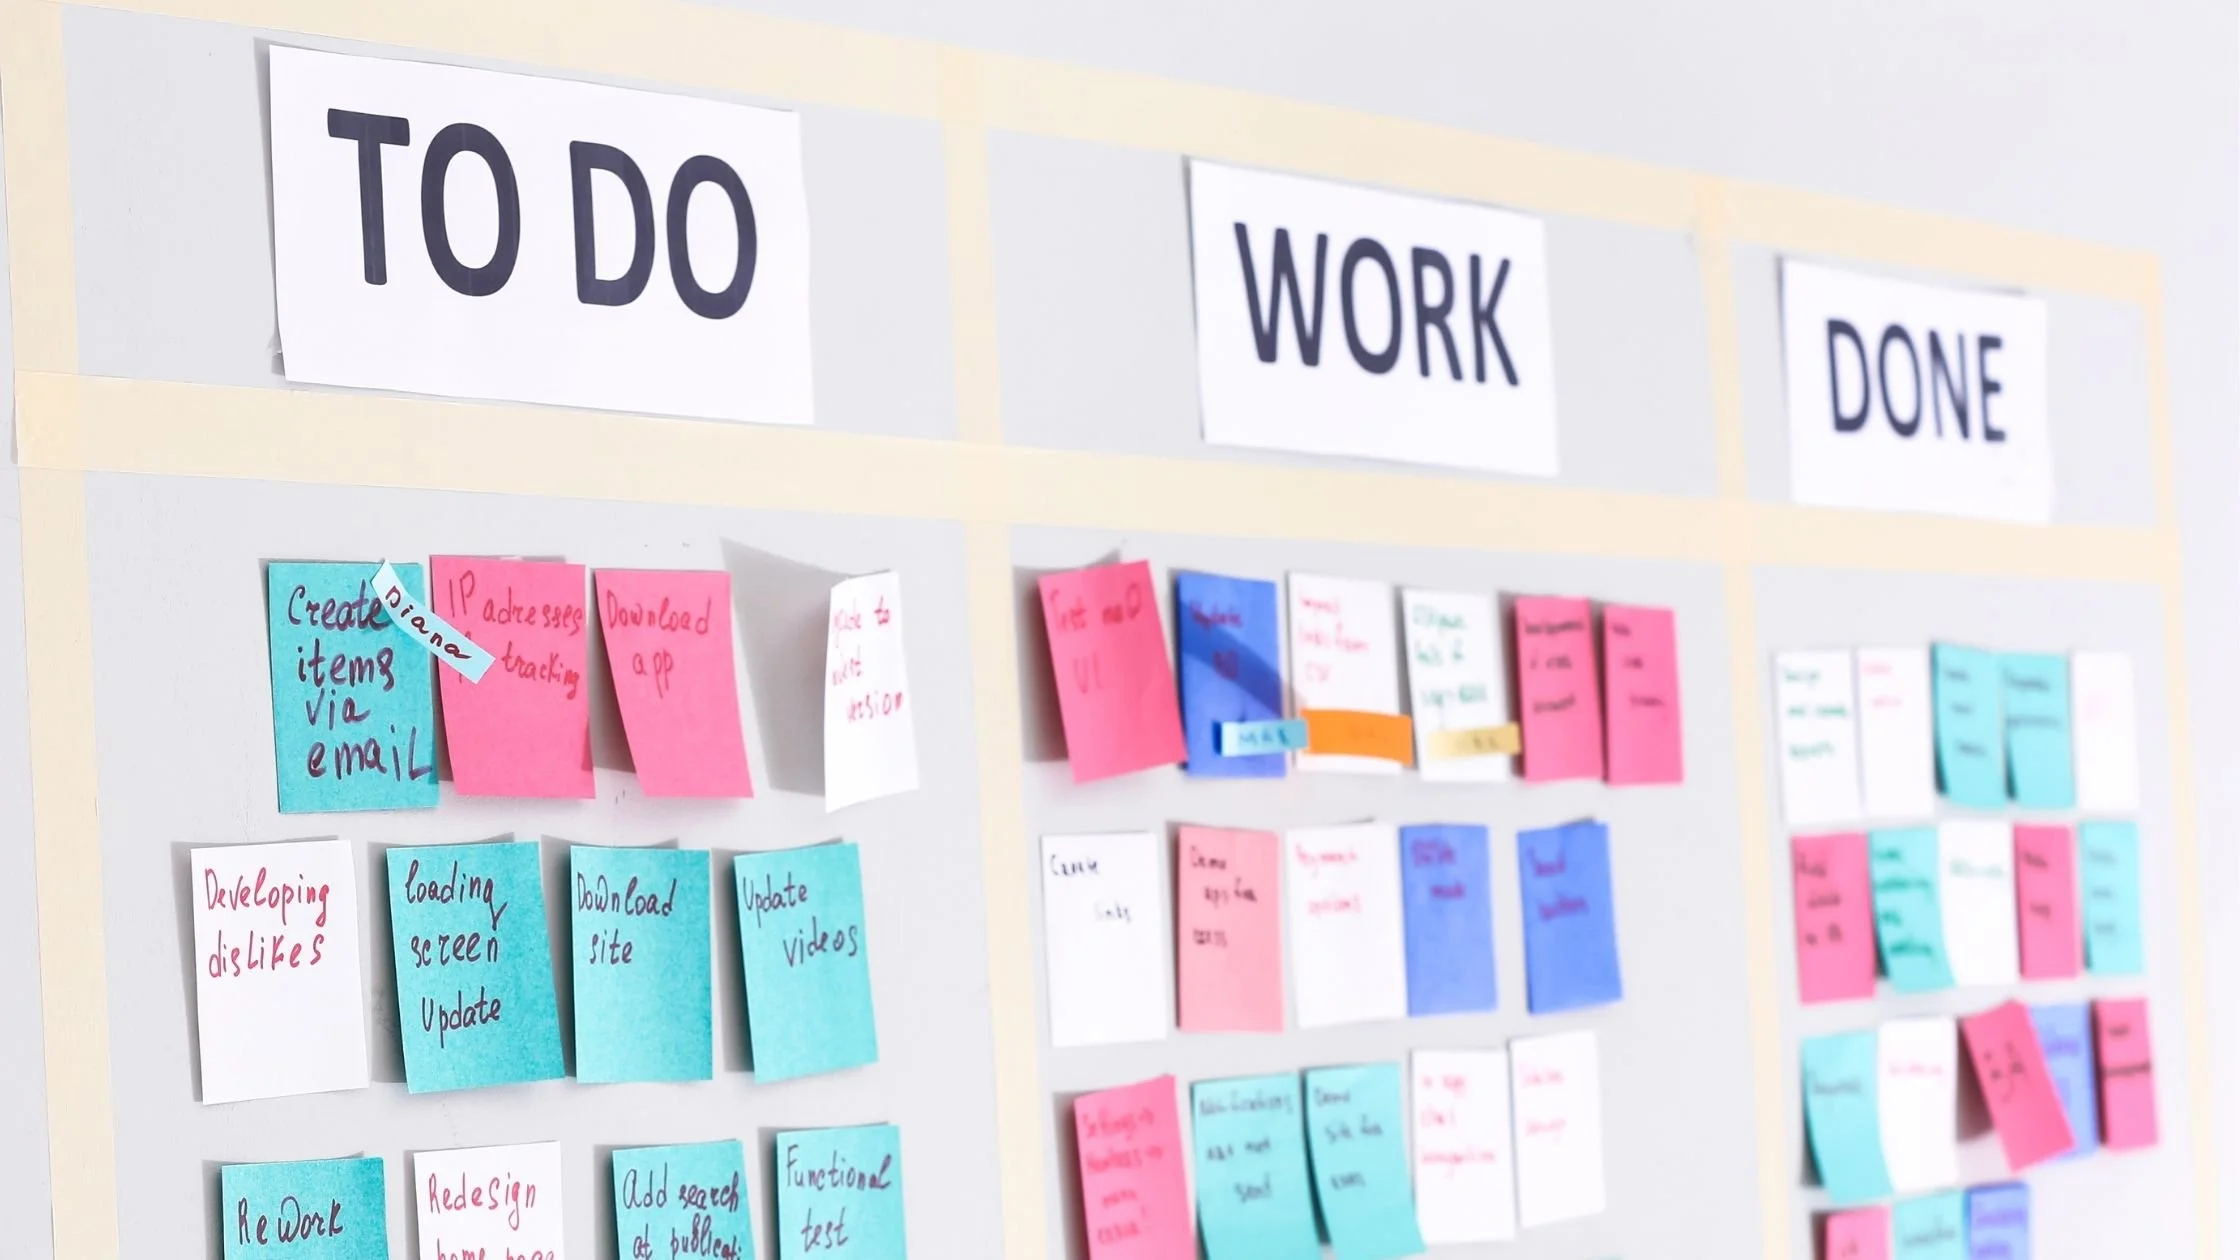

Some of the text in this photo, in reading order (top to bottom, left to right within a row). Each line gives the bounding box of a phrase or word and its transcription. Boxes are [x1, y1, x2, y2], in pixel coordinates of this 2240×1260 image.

[327, 107, 757, 320] TO DO
[1233, 222, 1519, 387] WORK
[1826, 318, 2006, 443] DONE
[288, 578, 391, 631] Create
[385, 585, 472, 659] Diana
[449, 570, 583, 635] IP adresses
[607, 589, 711, 635] Download
[299, 638, 394, 692] items
[502, 642, 579, 699] tracking
[632, 649, 673, 699] app
[305, 690, 370, 730] via
[205, 867, 330, 927] Developing
[743, 872, 808, 928] Update
[411, 932, 498, 968] screen
[590, 929, 633, 964] site
[784, 916, 858, 967] videos
[422, 986, 501, 1048] Update
[623, 1162, 739, 1212] Add search
[786, 1144, 892, 1190] Functional
[428, 1172, 536, 1231] Redesign
[633, 1223, 653, 1260] at
[801, 1206, 849, 1251] test
